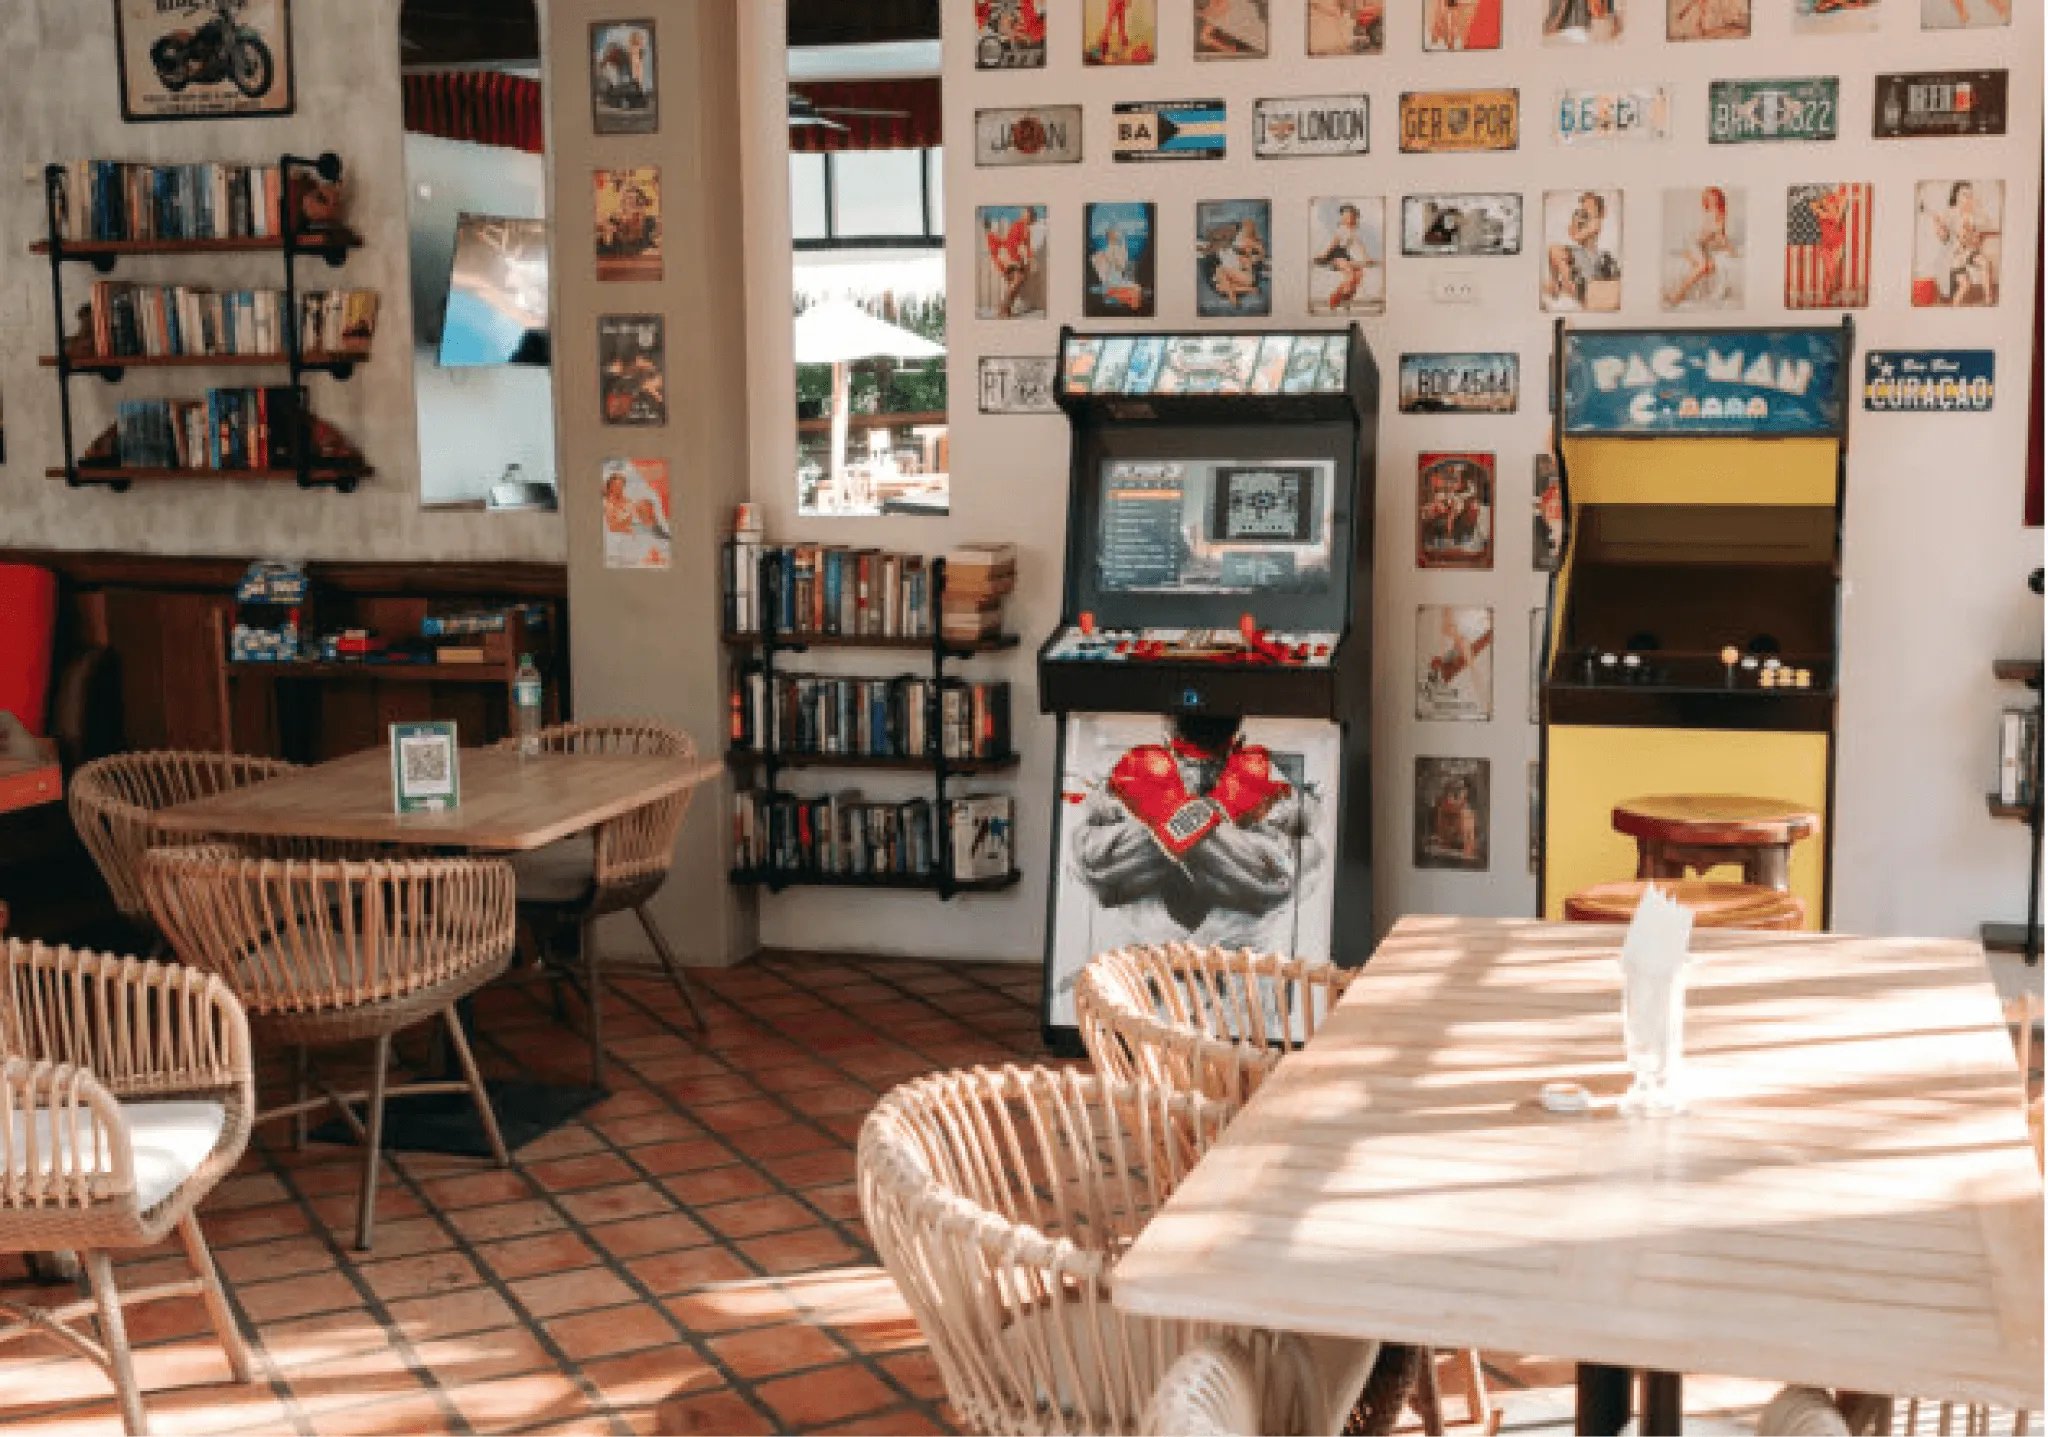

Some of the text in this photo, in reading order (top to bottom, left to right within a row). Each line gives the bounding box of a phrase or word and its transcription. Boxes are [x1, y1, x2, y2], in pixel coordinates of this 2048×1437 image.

[1118, 123, 1151, 141] BA
[1297, 109, 1364, 142] LONDON
[1405, 107, 1443, 139] GER
[1591, 345, 1814, 396] PAC-MAN
